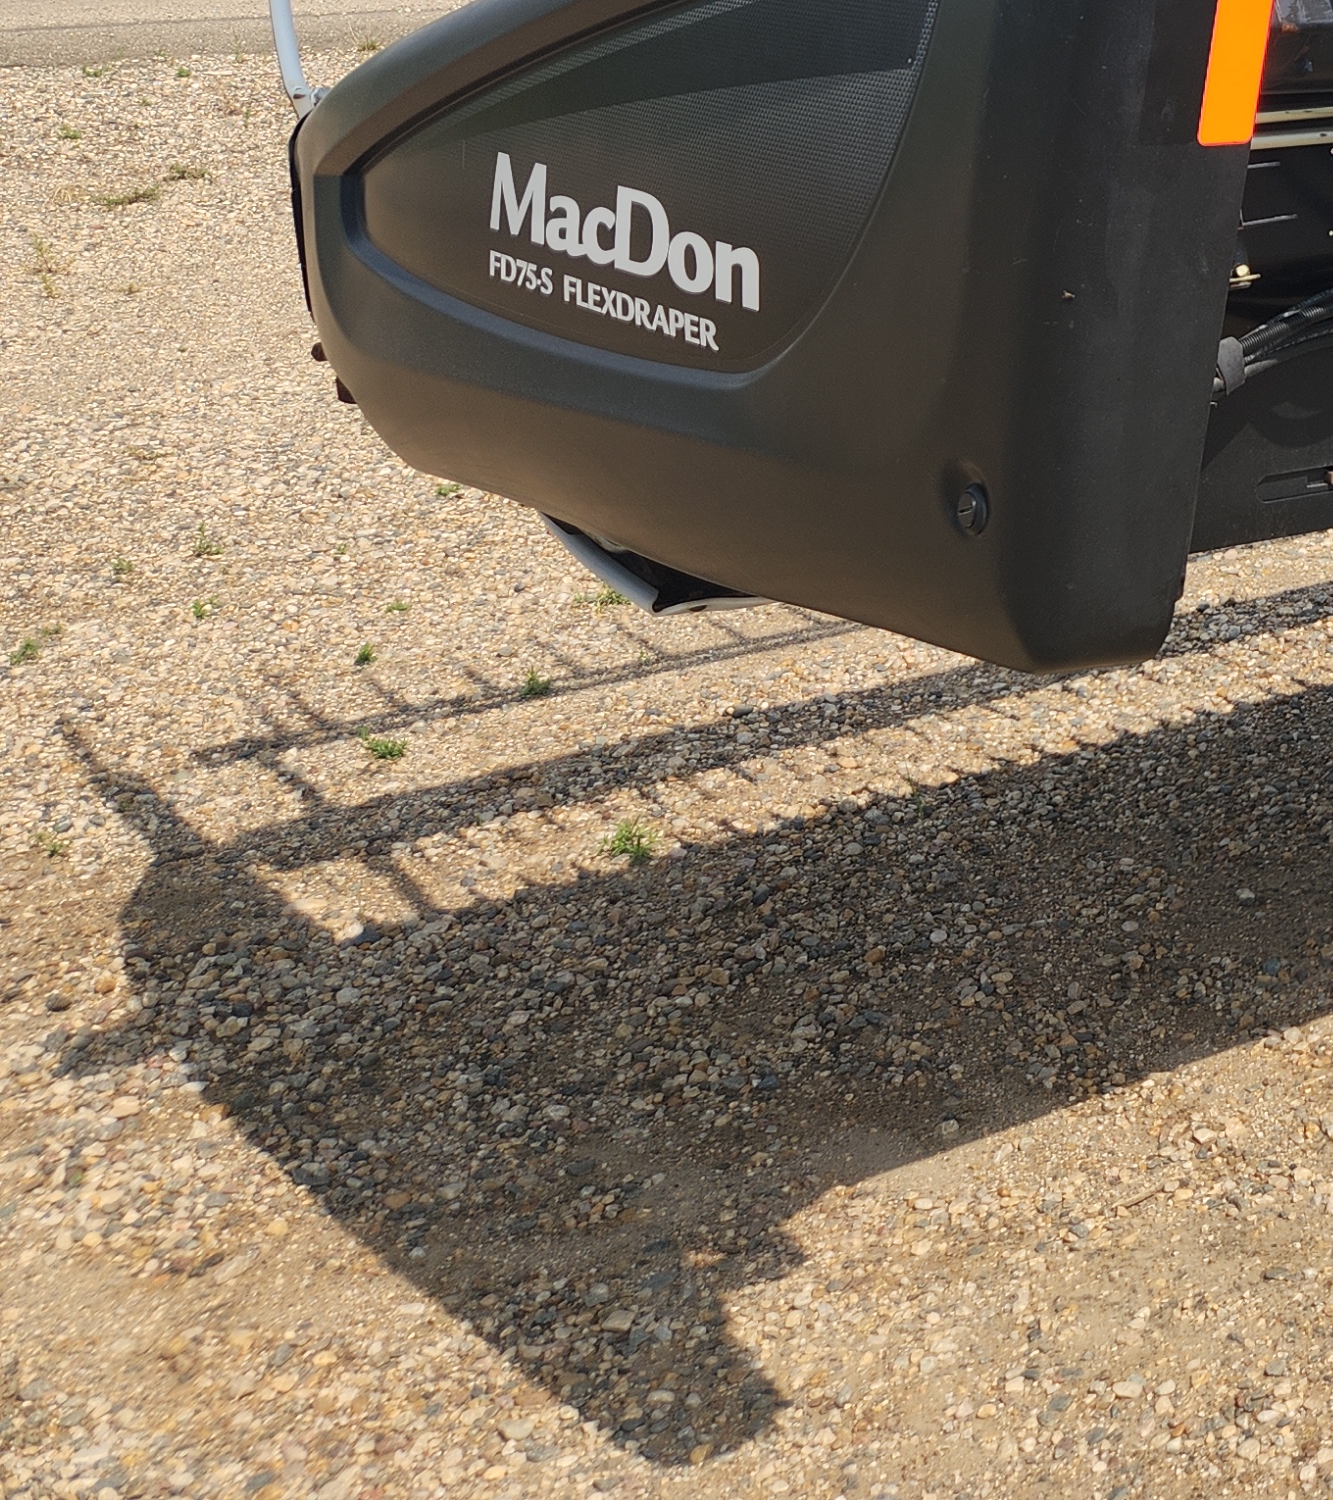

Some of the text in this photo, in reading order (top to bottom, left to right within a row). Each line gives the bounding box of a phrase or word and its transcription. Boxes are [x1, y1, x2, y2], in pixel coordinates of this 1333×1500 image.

[490, 151, 760, 312] MacDon
[489, 250, 720, 351] FD75-S FLEXDRAPER
